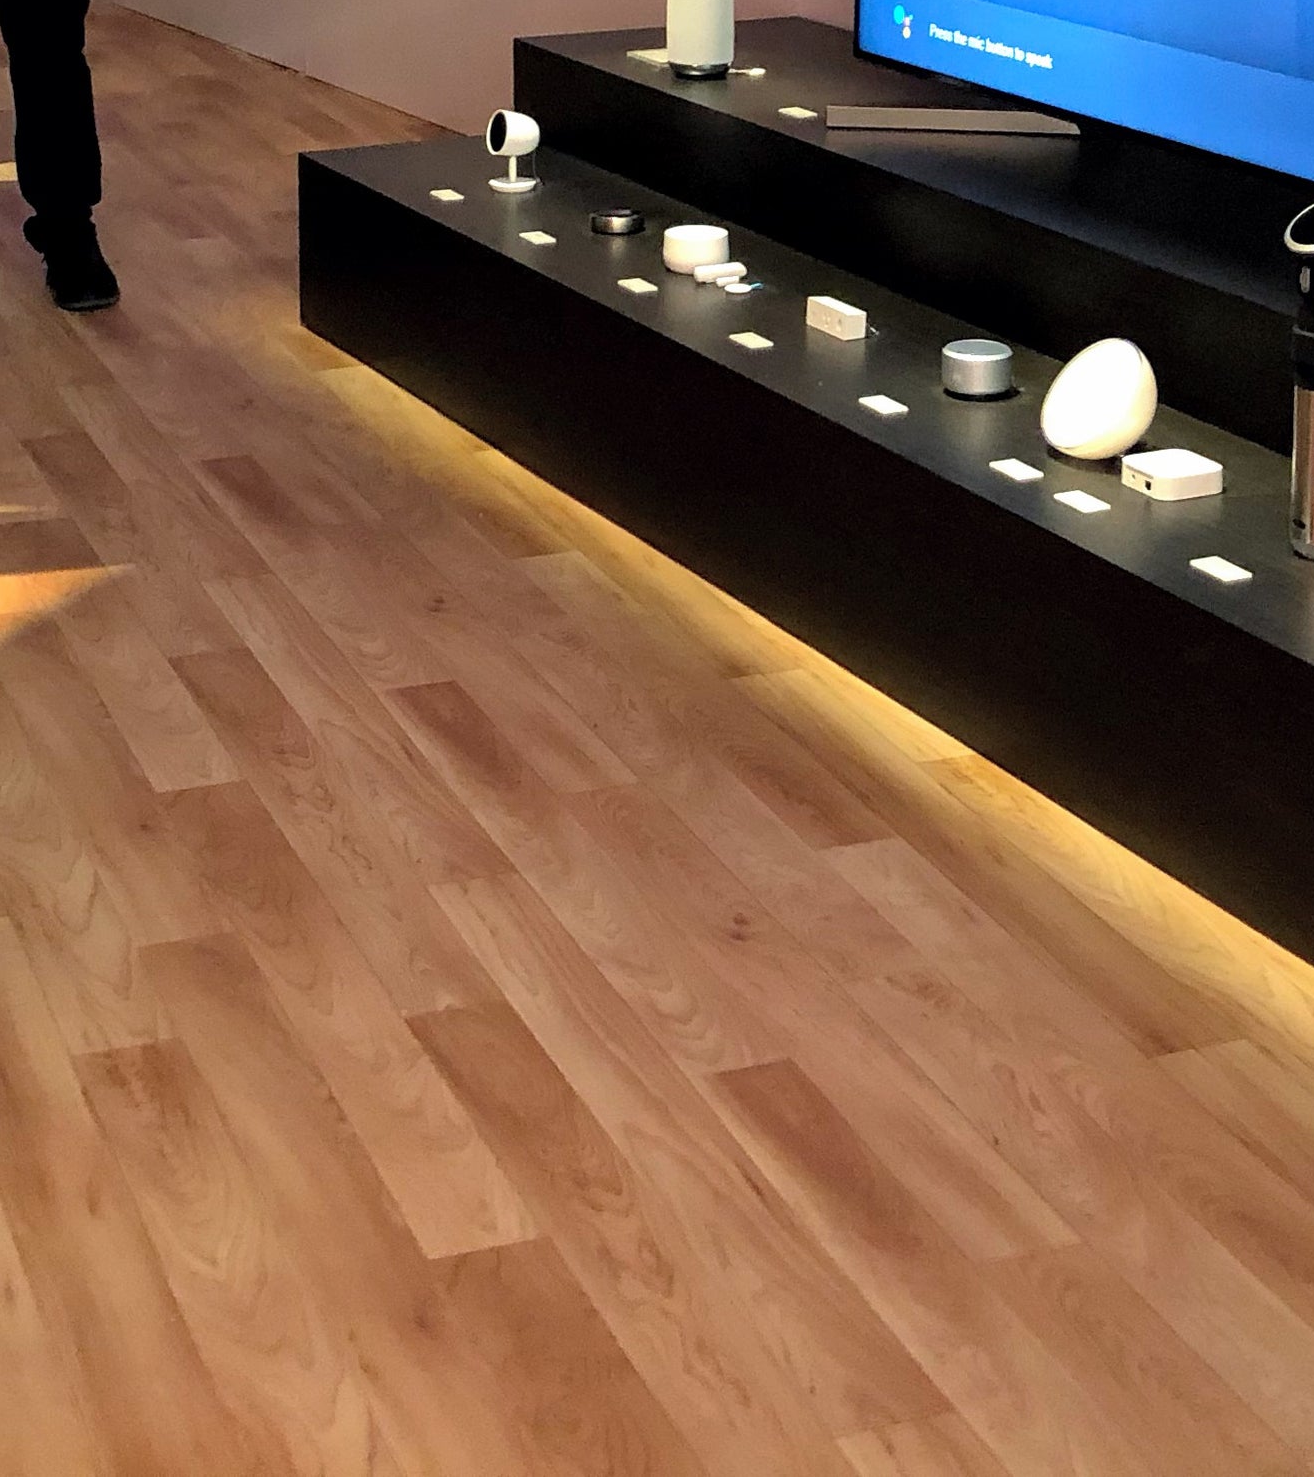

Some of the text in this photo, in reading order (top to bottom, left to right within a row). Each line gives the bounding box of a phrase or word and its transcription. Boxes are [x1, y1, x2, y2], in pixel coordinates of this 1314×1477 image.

[929, 23, 1054, 70] Press the mic button to speak
